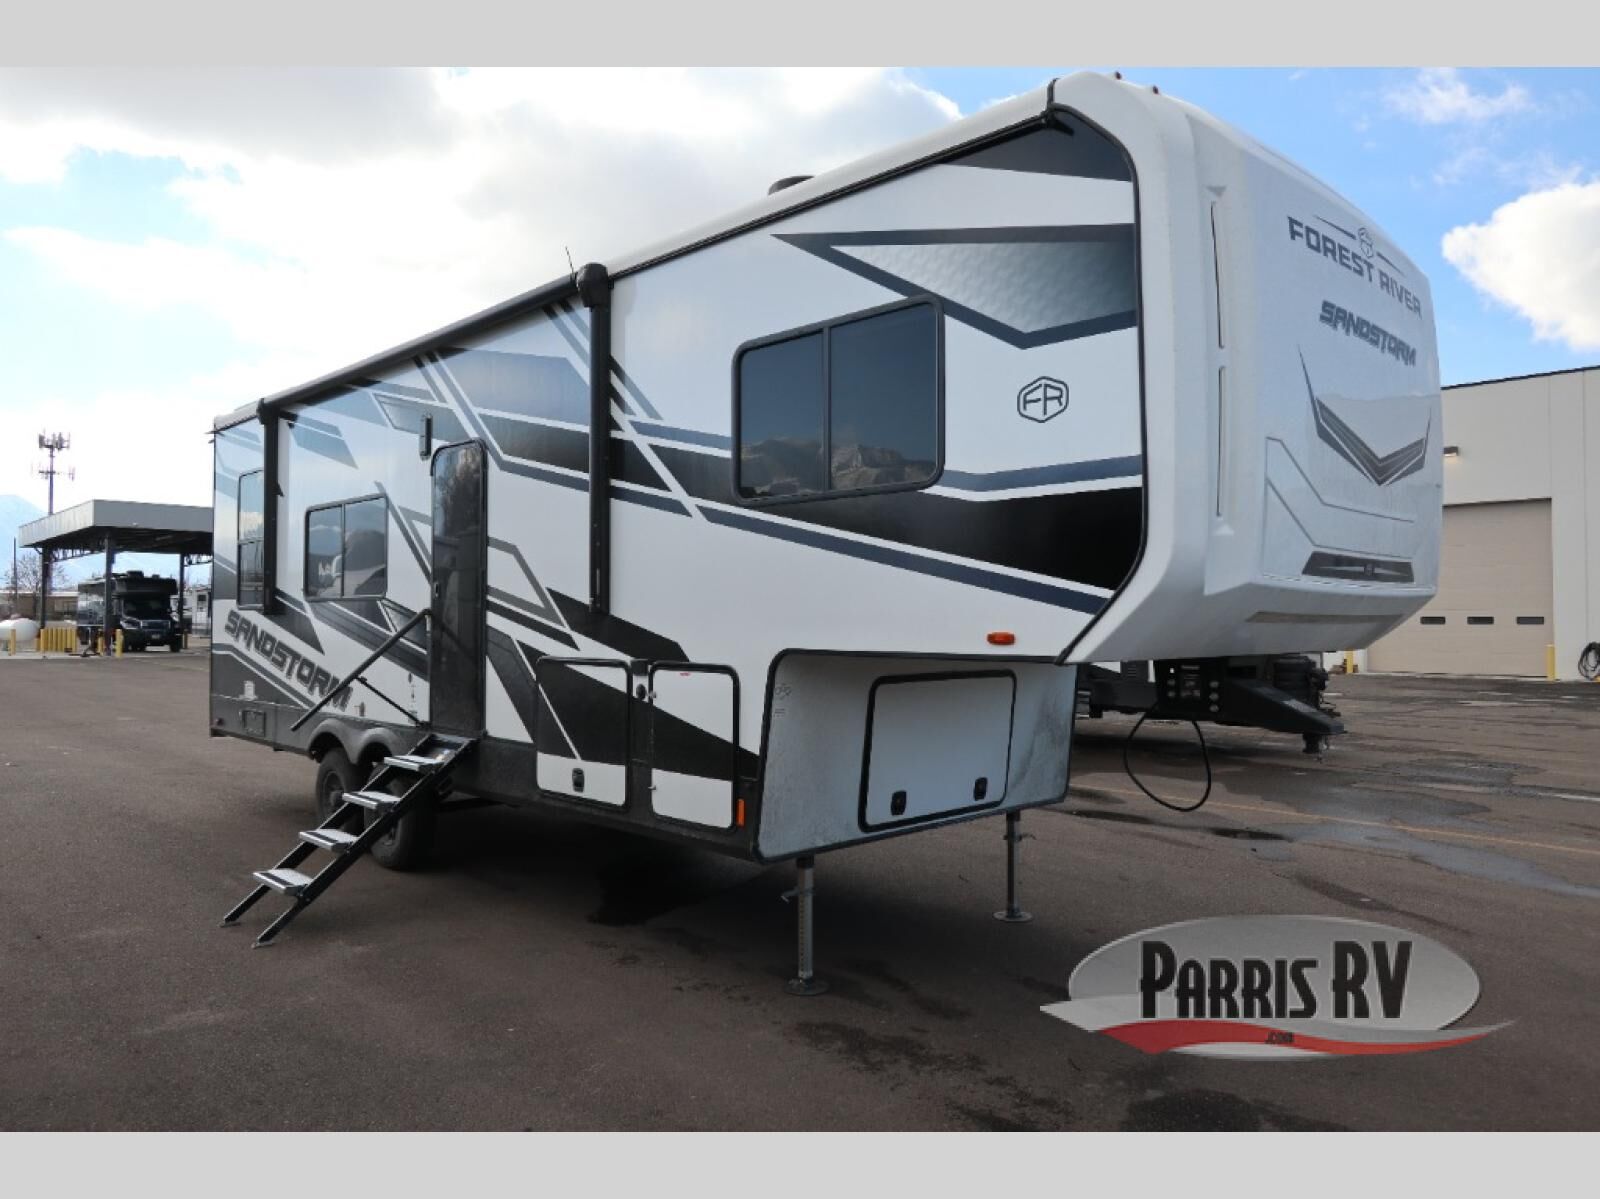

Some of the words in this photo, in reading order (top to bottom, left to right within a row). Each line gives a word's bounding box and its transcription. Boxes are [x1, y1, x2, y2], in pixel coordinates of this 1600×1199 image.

[1287, 216, 1374, 283] FOREST
[1379, 269, 1422, 320] RIVER
[1319, 299, 1416, 367] SANDSTORM
